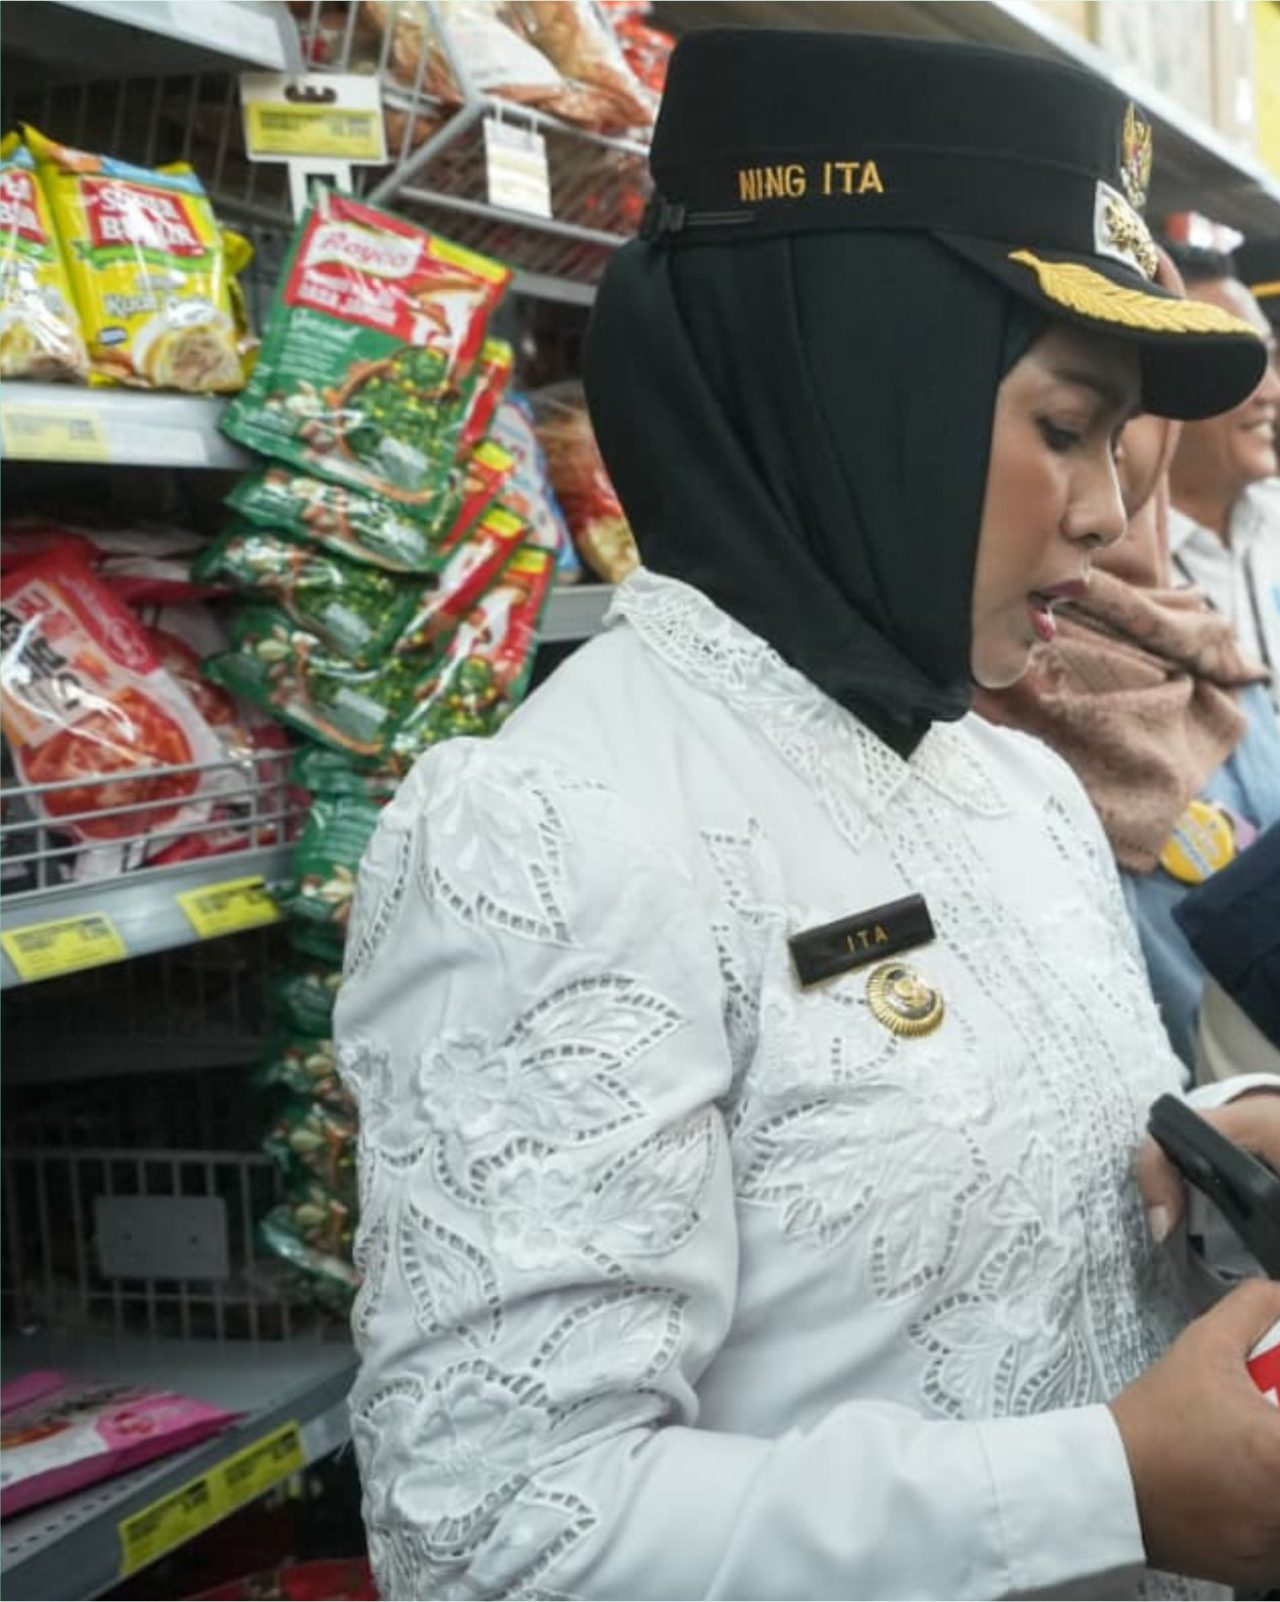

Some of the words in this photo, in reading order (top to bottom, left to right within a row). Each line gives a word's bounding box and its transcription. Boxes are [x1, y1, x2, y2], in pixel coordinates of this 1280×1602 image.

[739, 164, 806, 202] NING
[823, 160, 884, 195] ITA
[846, 924, 889, 953] ITA
